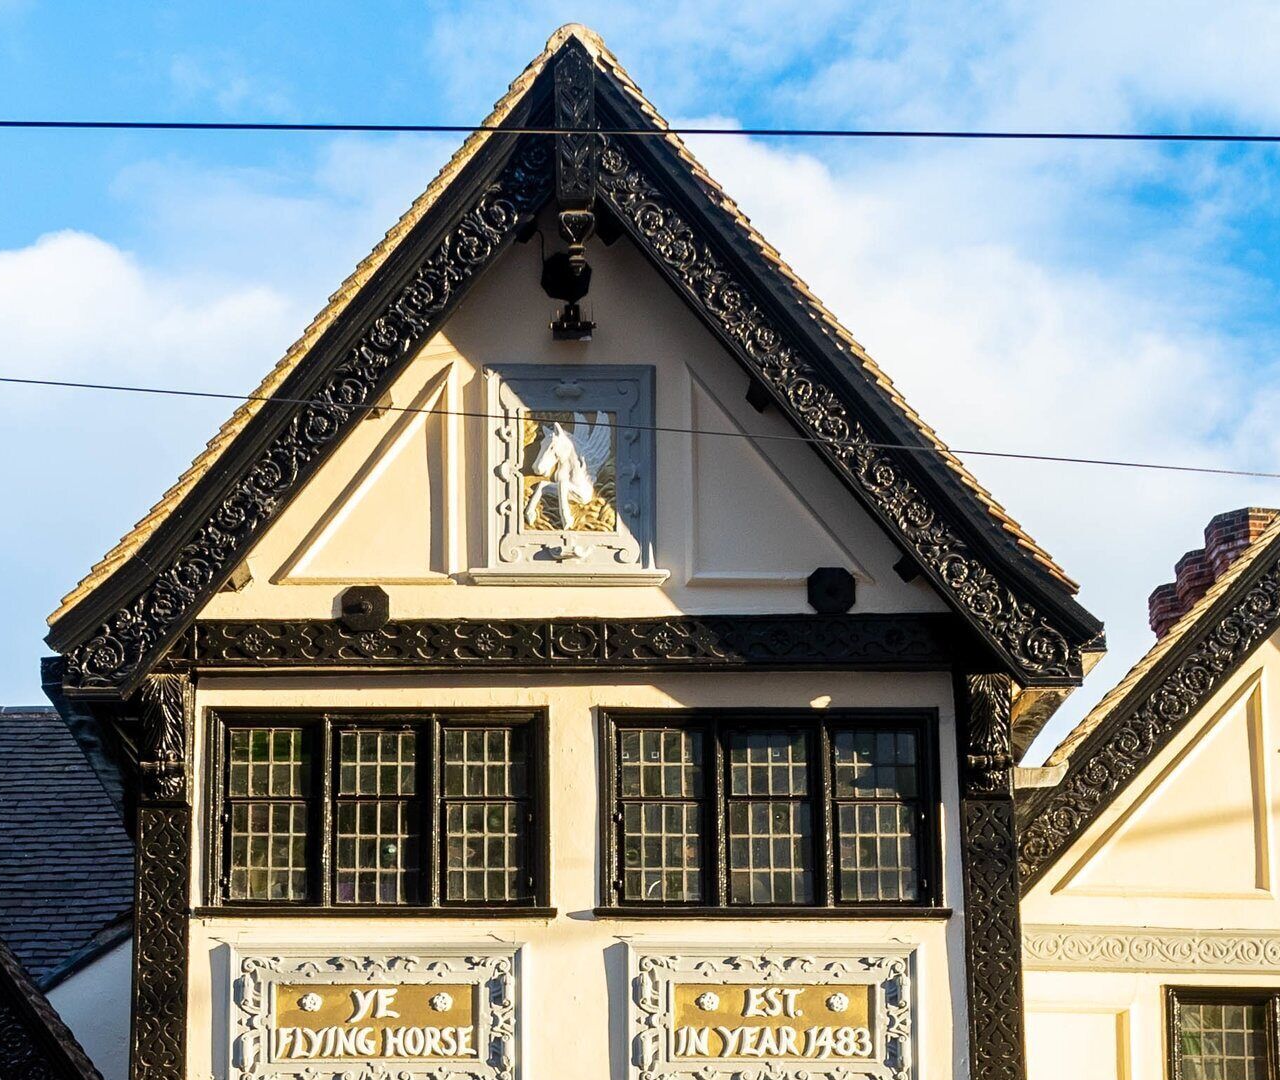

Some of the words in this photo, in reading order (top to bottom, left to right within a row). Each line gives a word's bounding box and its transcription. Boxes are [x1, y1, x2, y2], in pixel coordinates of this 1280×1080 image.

[346, 988, 401, 1023] YE
[744, 988, 805, 1019] EST.
[275, 1026, 376, 1059] FLYING
[384, 1025, 477, 1057] HORSE
[675, 1025, 710, 1057] IN
[716, 1026, 800, 1057] YEAR
[803, 1026, 873, 1059] 1483
